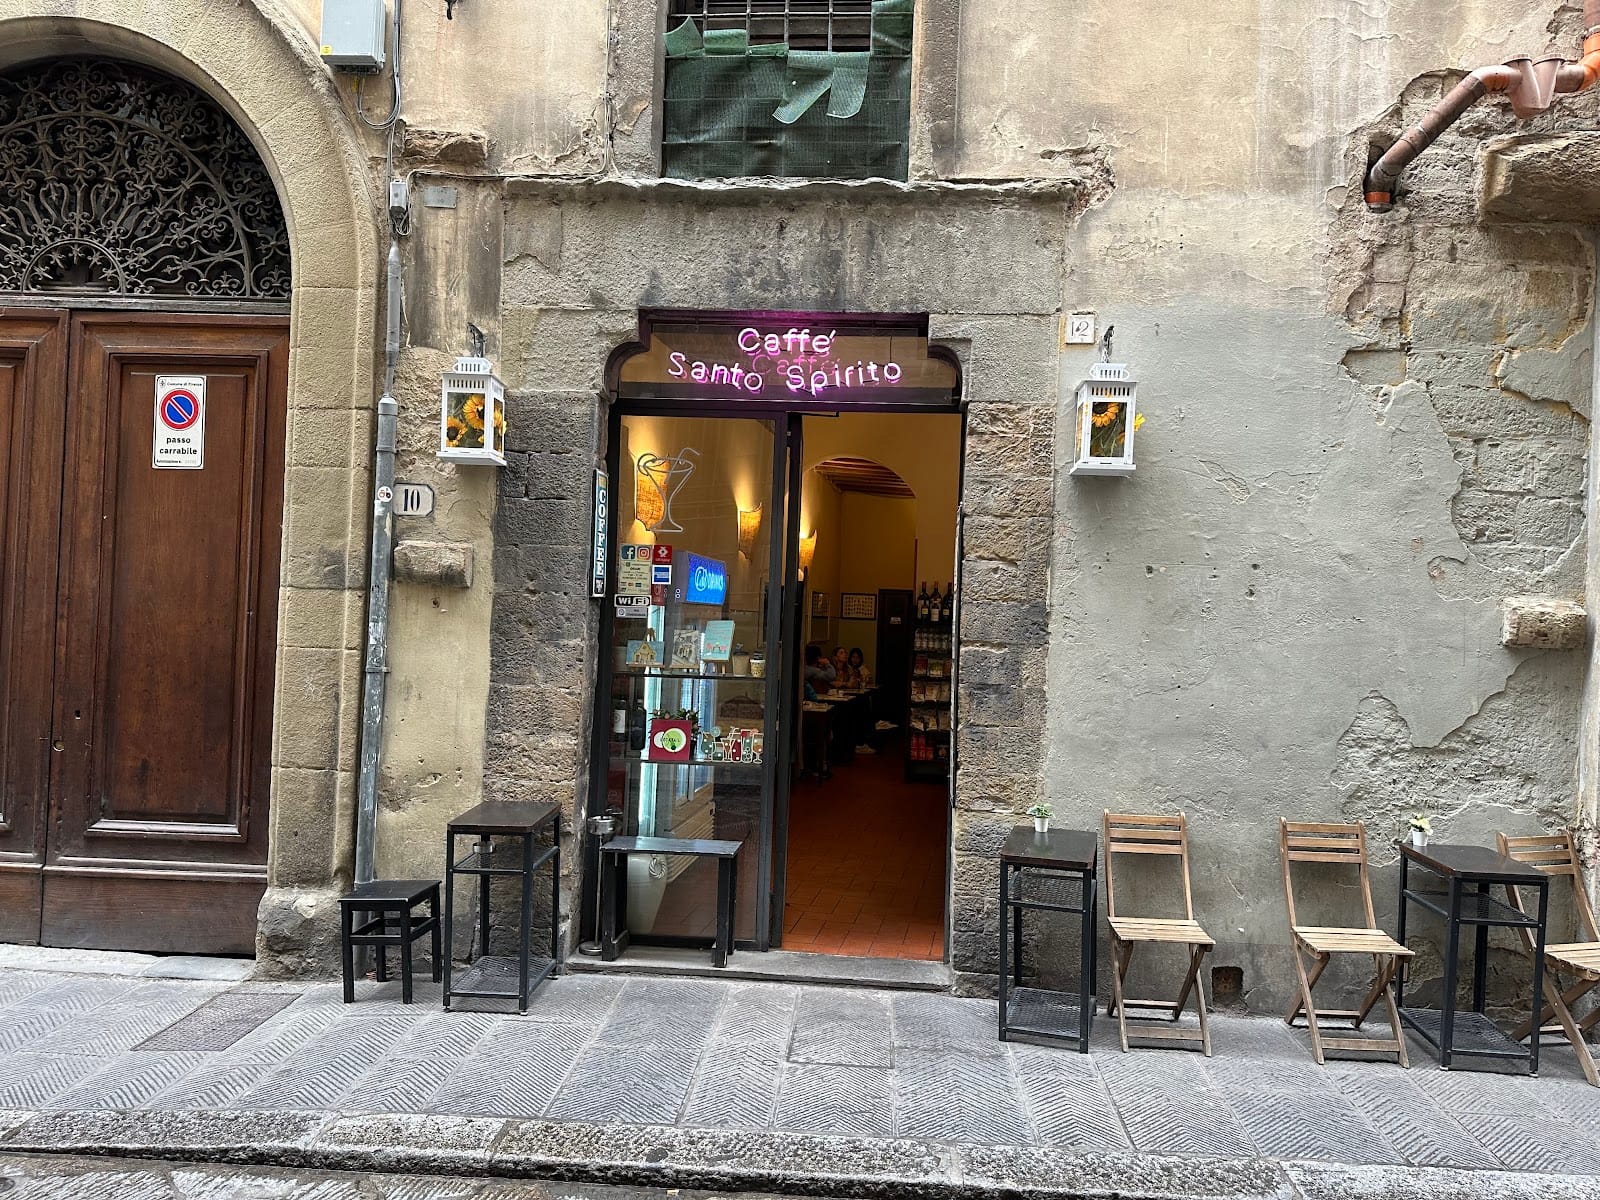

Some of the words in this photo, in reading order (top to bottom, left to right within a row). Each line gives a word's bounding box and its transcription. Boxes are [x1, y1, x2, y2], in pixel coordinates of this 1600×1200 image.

[1071, 321, 1089, 336] 12
[667, 351, 763, 391] Santo
[785, 360, 902, 397] Spirito
[159, 446, 198, 455] carrabile
[166, 437, 191, 445] passo
[403, 488, 421, 512] 10
[596, 489, 606, 576] COFFEE
